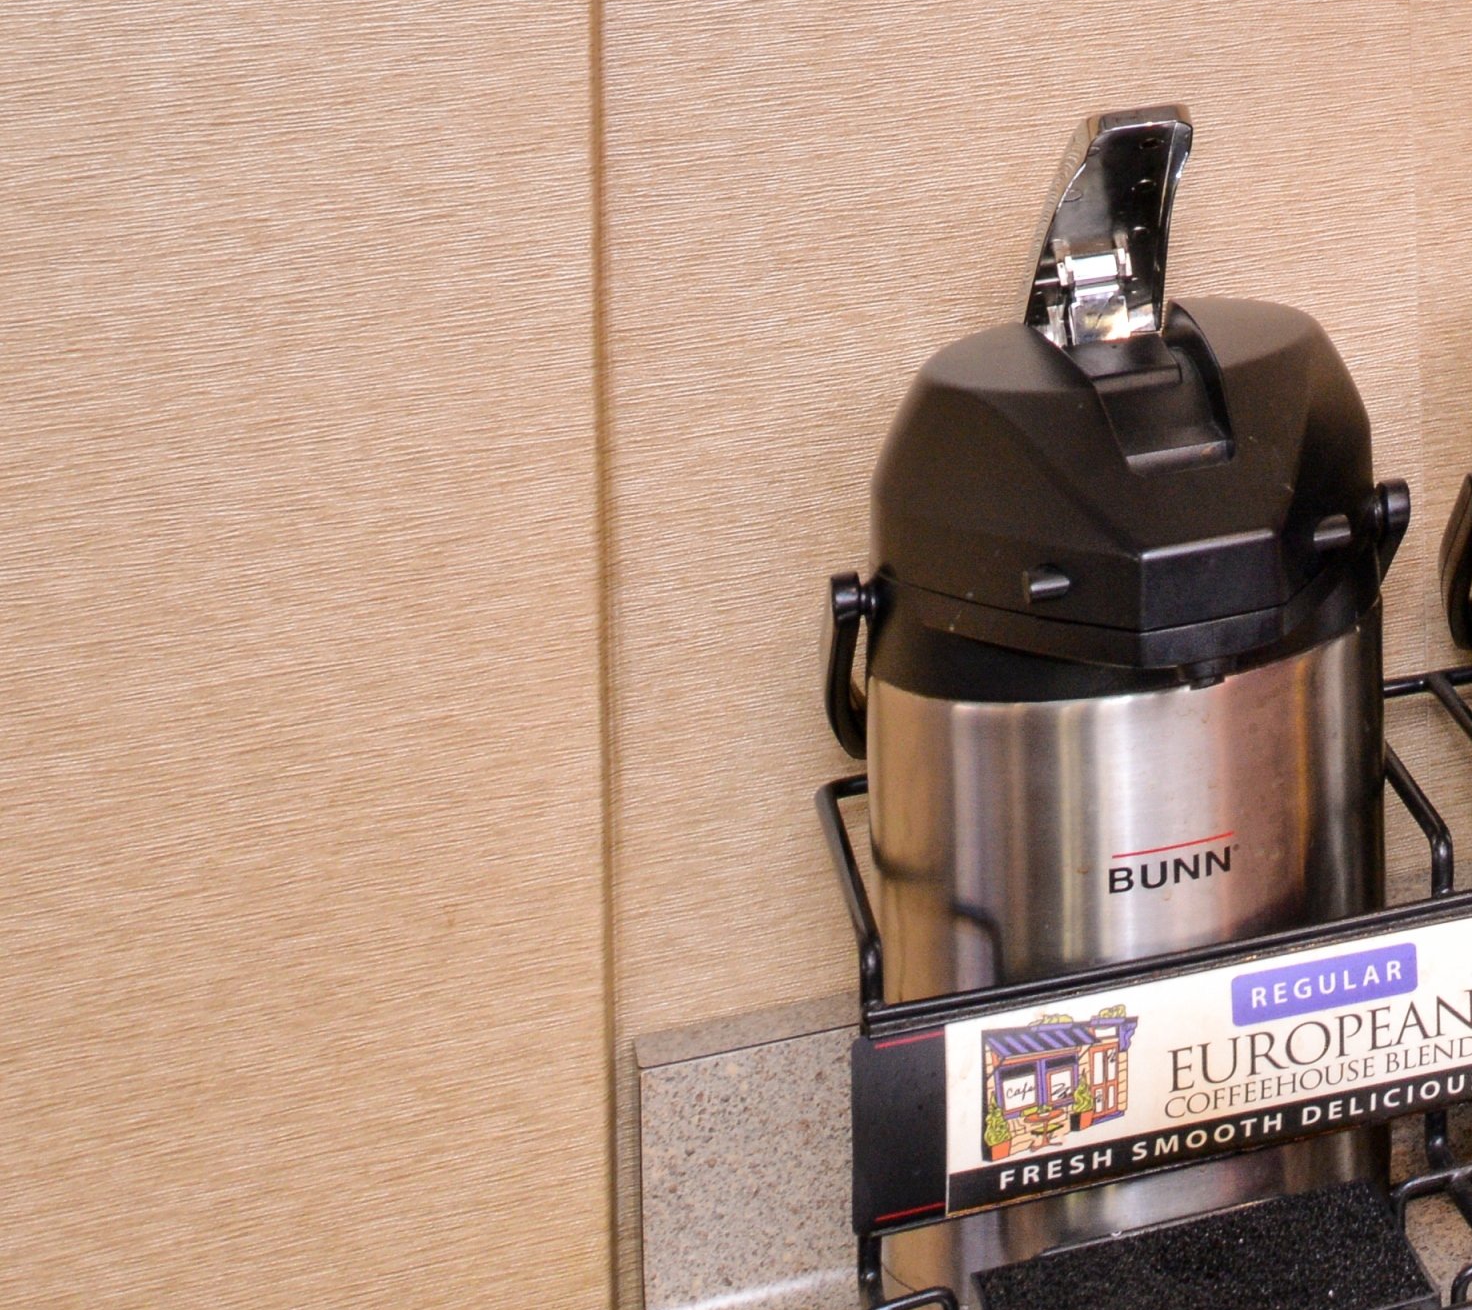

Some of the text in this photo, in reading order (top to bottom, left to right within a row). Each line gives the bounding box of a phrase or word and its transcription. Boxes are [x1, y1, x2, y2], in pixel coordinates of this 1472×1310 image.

[1109, 846, 1230, 894] BUNN
[1251, 960, 1402, 1009] REGULAR
[1163, 1056, 1376, 1120] COFFEEHOUSE
[999, 1147, 1114, 1190] FRESH
[1132, 1111, 1283, 1163] SMOOTH
